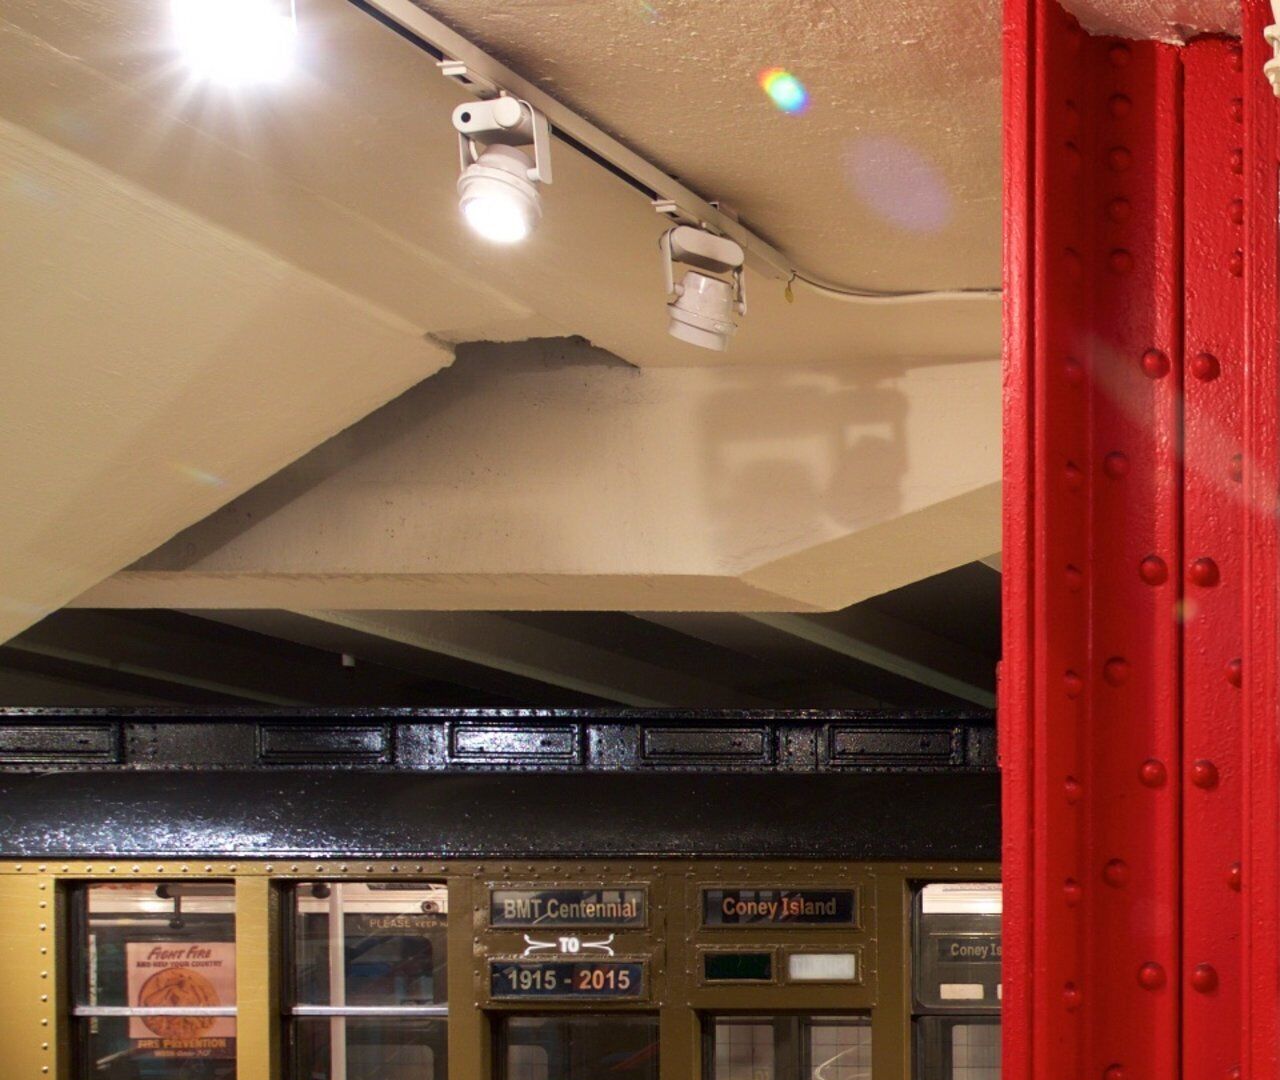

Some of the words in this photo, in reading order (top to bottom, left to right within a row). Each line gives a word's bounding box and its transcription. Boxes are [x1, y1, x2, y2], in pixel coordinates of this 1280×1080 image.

[504, 899, 542, 918] BMT
[547, 898, 637, 918] Centennial
[723, 897, 778, 919] Coney
[781, 897, 837, 916] Island
[558, 937, 580, 953] TO
[950, 943, 989, 959] Coney
[508, 969, 557, 989] 1915
[579, 969, 630, 990] 2015
